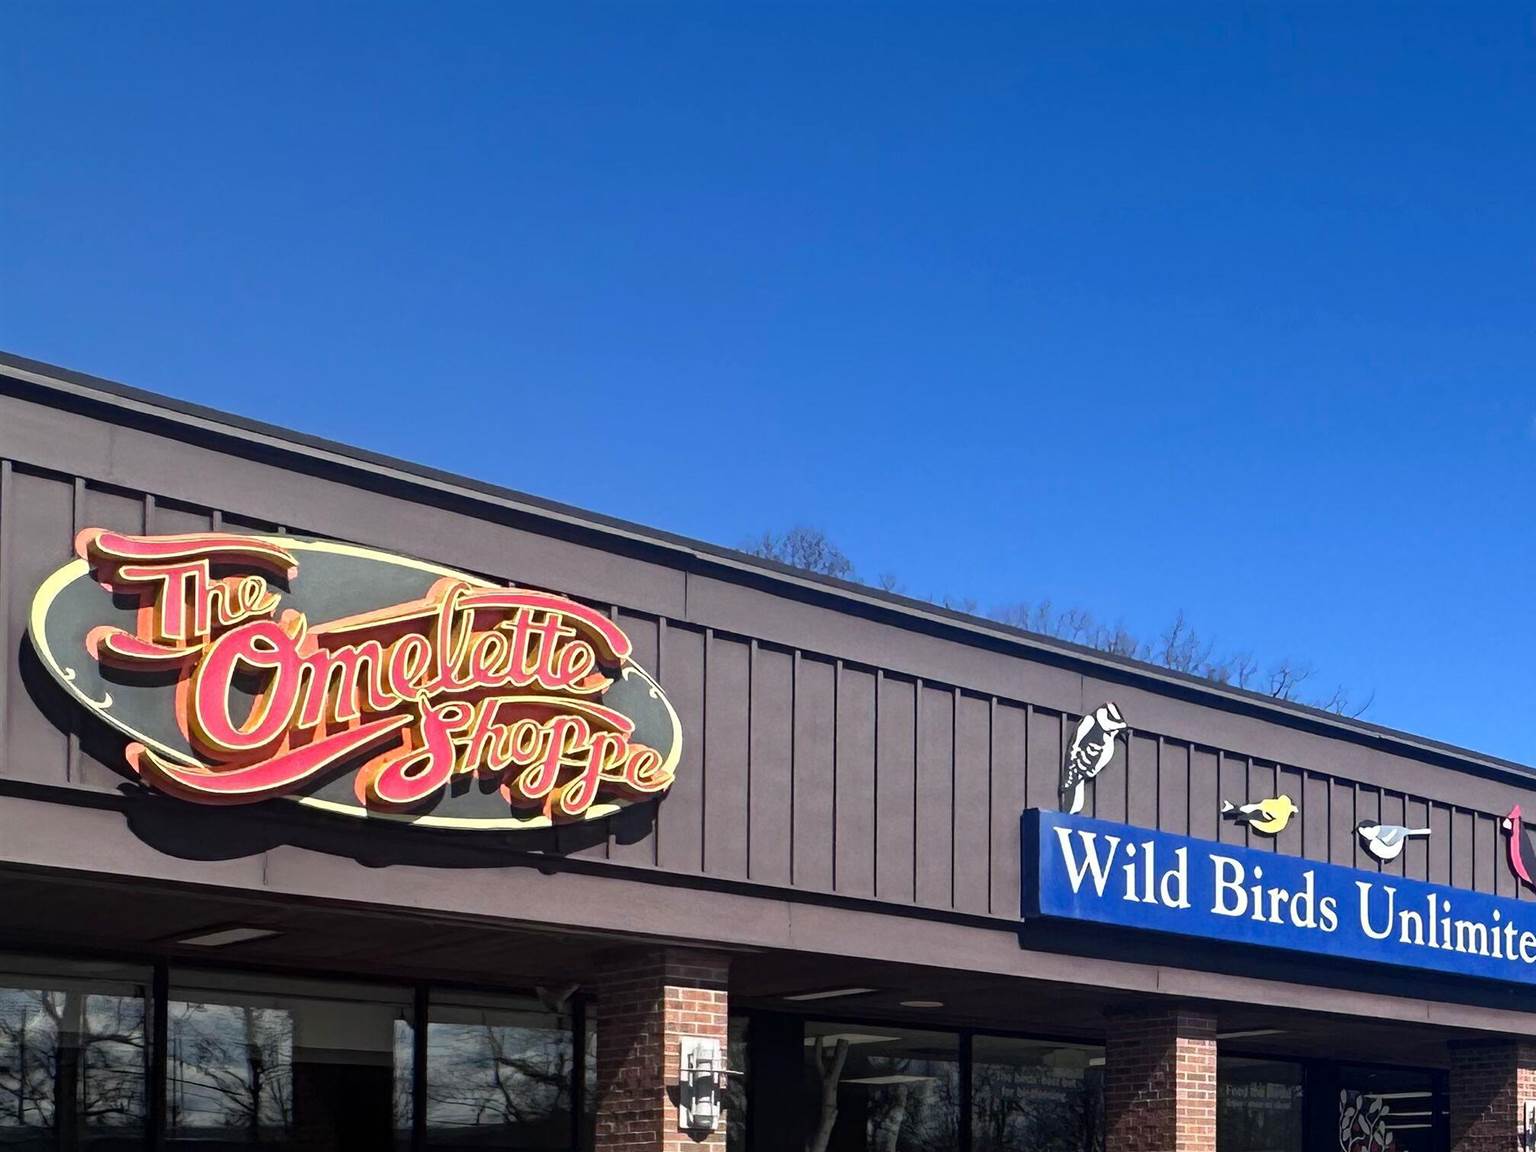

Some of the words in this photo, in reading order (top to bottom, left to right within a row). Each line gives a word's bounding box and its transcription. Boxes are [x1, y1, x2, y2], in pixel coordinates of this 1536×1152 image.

[98, 535, 296, 655] The
[188, 580, 618, 756] Omelette
[372, 694, 674, 817] Shoppe
[1052, 826, 1191, 910] Wild
[1210, 854, 1339, 934] Birds
